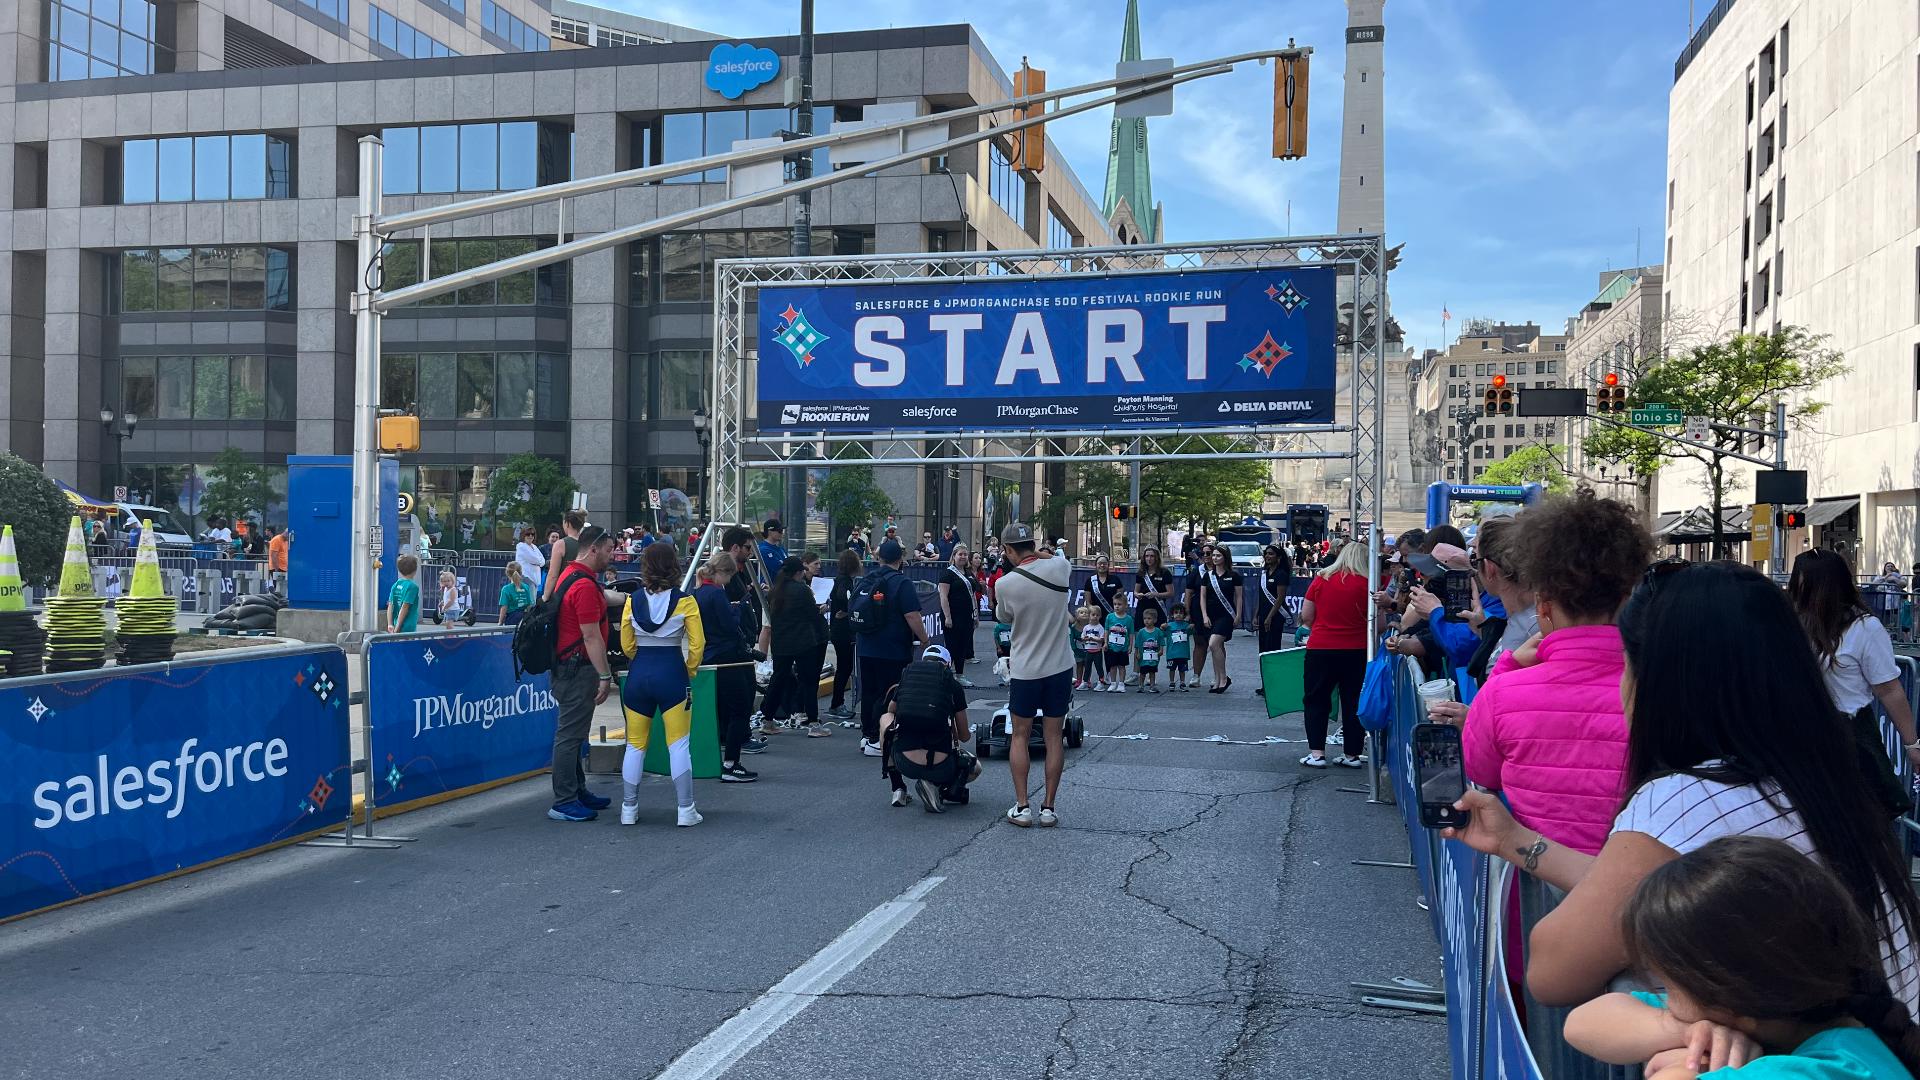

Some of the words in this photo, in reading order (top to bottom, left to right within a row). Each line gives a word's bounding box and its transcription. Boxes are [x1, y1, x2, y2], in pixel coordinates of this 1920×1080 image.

[714, 60, 773, 75] salesforce
[855, 299, 929, 311] SALESFORCE
[934, 299, 941, 308] &
[945, 297, 1050, 308] JPMORGANCHASE
[1054, 296, 1078, 307] 500
[1082, 293, 1141, 306] FESTIVAL
[1145, 291, 1191, 303] ROOKIE
[1196, 289, 1222, 300] RUN
[853, 304, 1227, 388] START
[1117, 396, 1141, 404] Peyton
[1142, 395, 1174, 403] Manning
[1233, 402, 1267, 412] DELTA
[1268, 400, 1312, 411] DENTAL
[902, 405, 958, 420] salesforce
[996, 404, 1079, 418] JPMorganChase
[1147, 403, 1178, 412] Hospital
[801, 412, 841, 422] ROOKIE
[841, 412, 870, 422] RUN
[1634, 413, 1661, 422] Ohio
[1665, 413, 1679, 422] St
[33, 737, 289, 829] salesforce
